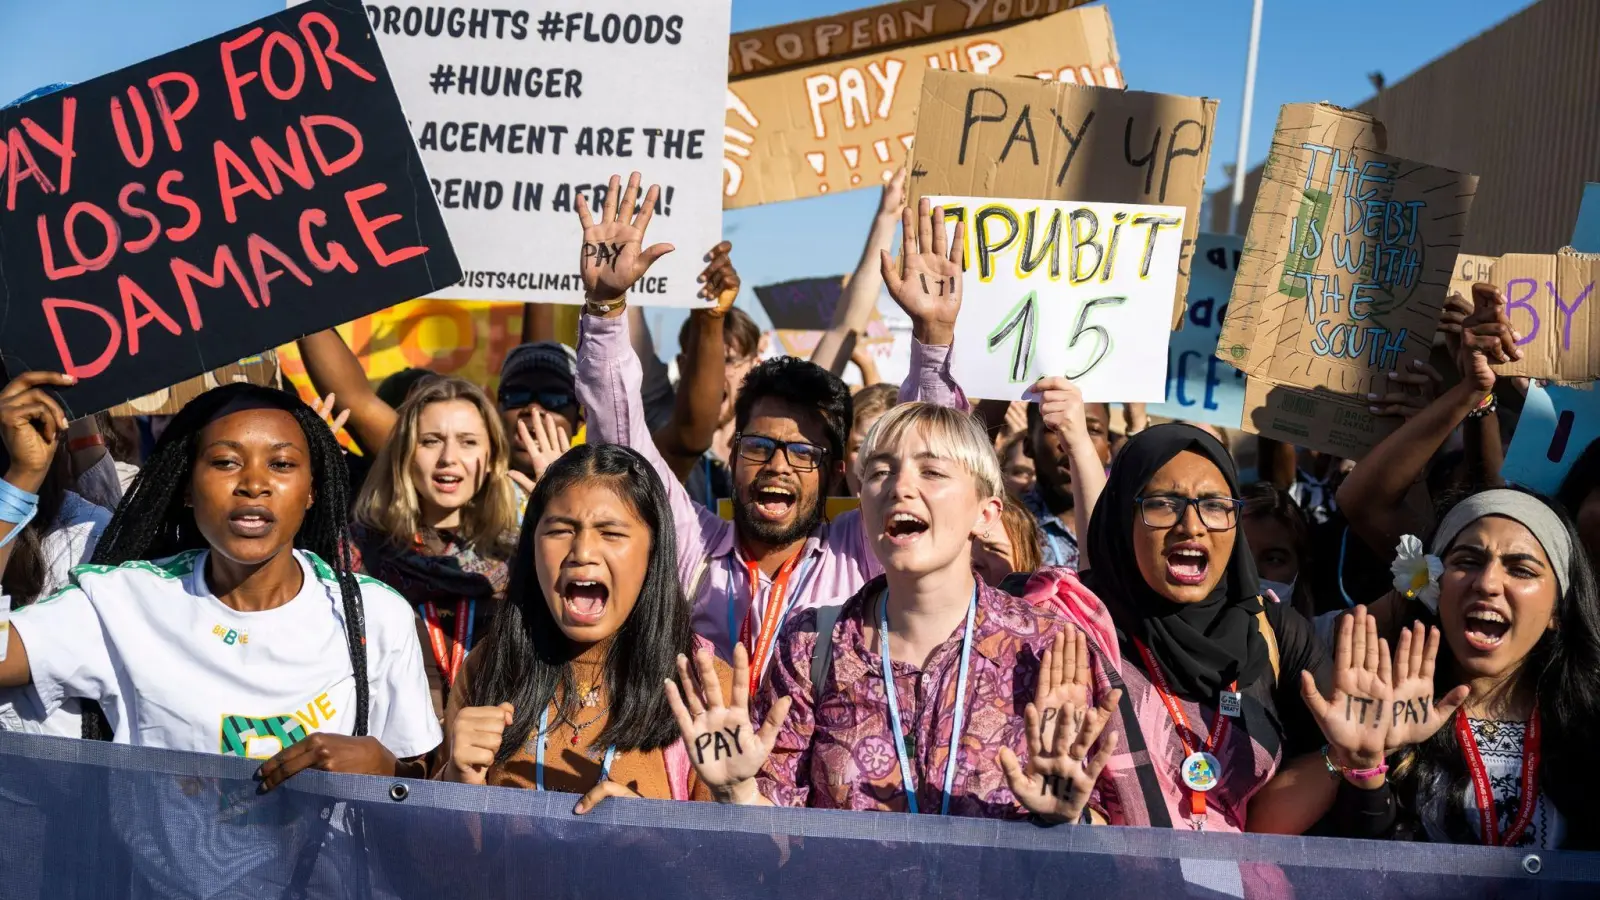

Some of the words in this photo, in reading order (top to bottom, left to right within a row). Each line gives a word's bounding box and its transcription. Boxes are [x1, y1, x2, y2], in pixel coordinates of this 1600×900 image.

[366, 4, 529, 40] DROUGHTS
[537, 11, 683, 45] #FLOODS
[729, 4, 937, 72] ROPEAN
[962, 0, 1073, 29] YOU
[110, 72, 199, 168] UP
[219, 11, 377, 121] FOR
[429, 64, 583, 98] #HUNGER
[804, 58, 905, 140] PAY
[408, 120, 568, 155] ACEMENT
[574, 126, 635, 158] ARE
[643, 128, 706, 160] THE
[957, 87, 1096, 187] PAY
[512, 181, 543, 212] IN
[1301, 142, 1389, 200] THE
[37, 169, 202, 281] LOSS
[213, 115, 364, 223] AND
[1343, 196, 1427, 246] DEBT
[582, 241, 627, 274] PAY
[1288, 216, 1323, 260] IS
[1330, 232, 1421, 290] WITH
[42, 183, 429, 381] DAMAGE
[1285, 270, 1382, 325] THE
[989, 296, 1126, 381] 15
[1504, 277, 1596, 351] BY
[1310, 319, 1407, 372] SOUTH
[1040, 707, 1083, 733] PY
[1345, 694, 1384, 729] IT!
[1392, 694, 1431, 727] PAY
[695, 725, 745, 765] PAY
[1041, 773, 1074, 801] IT!
